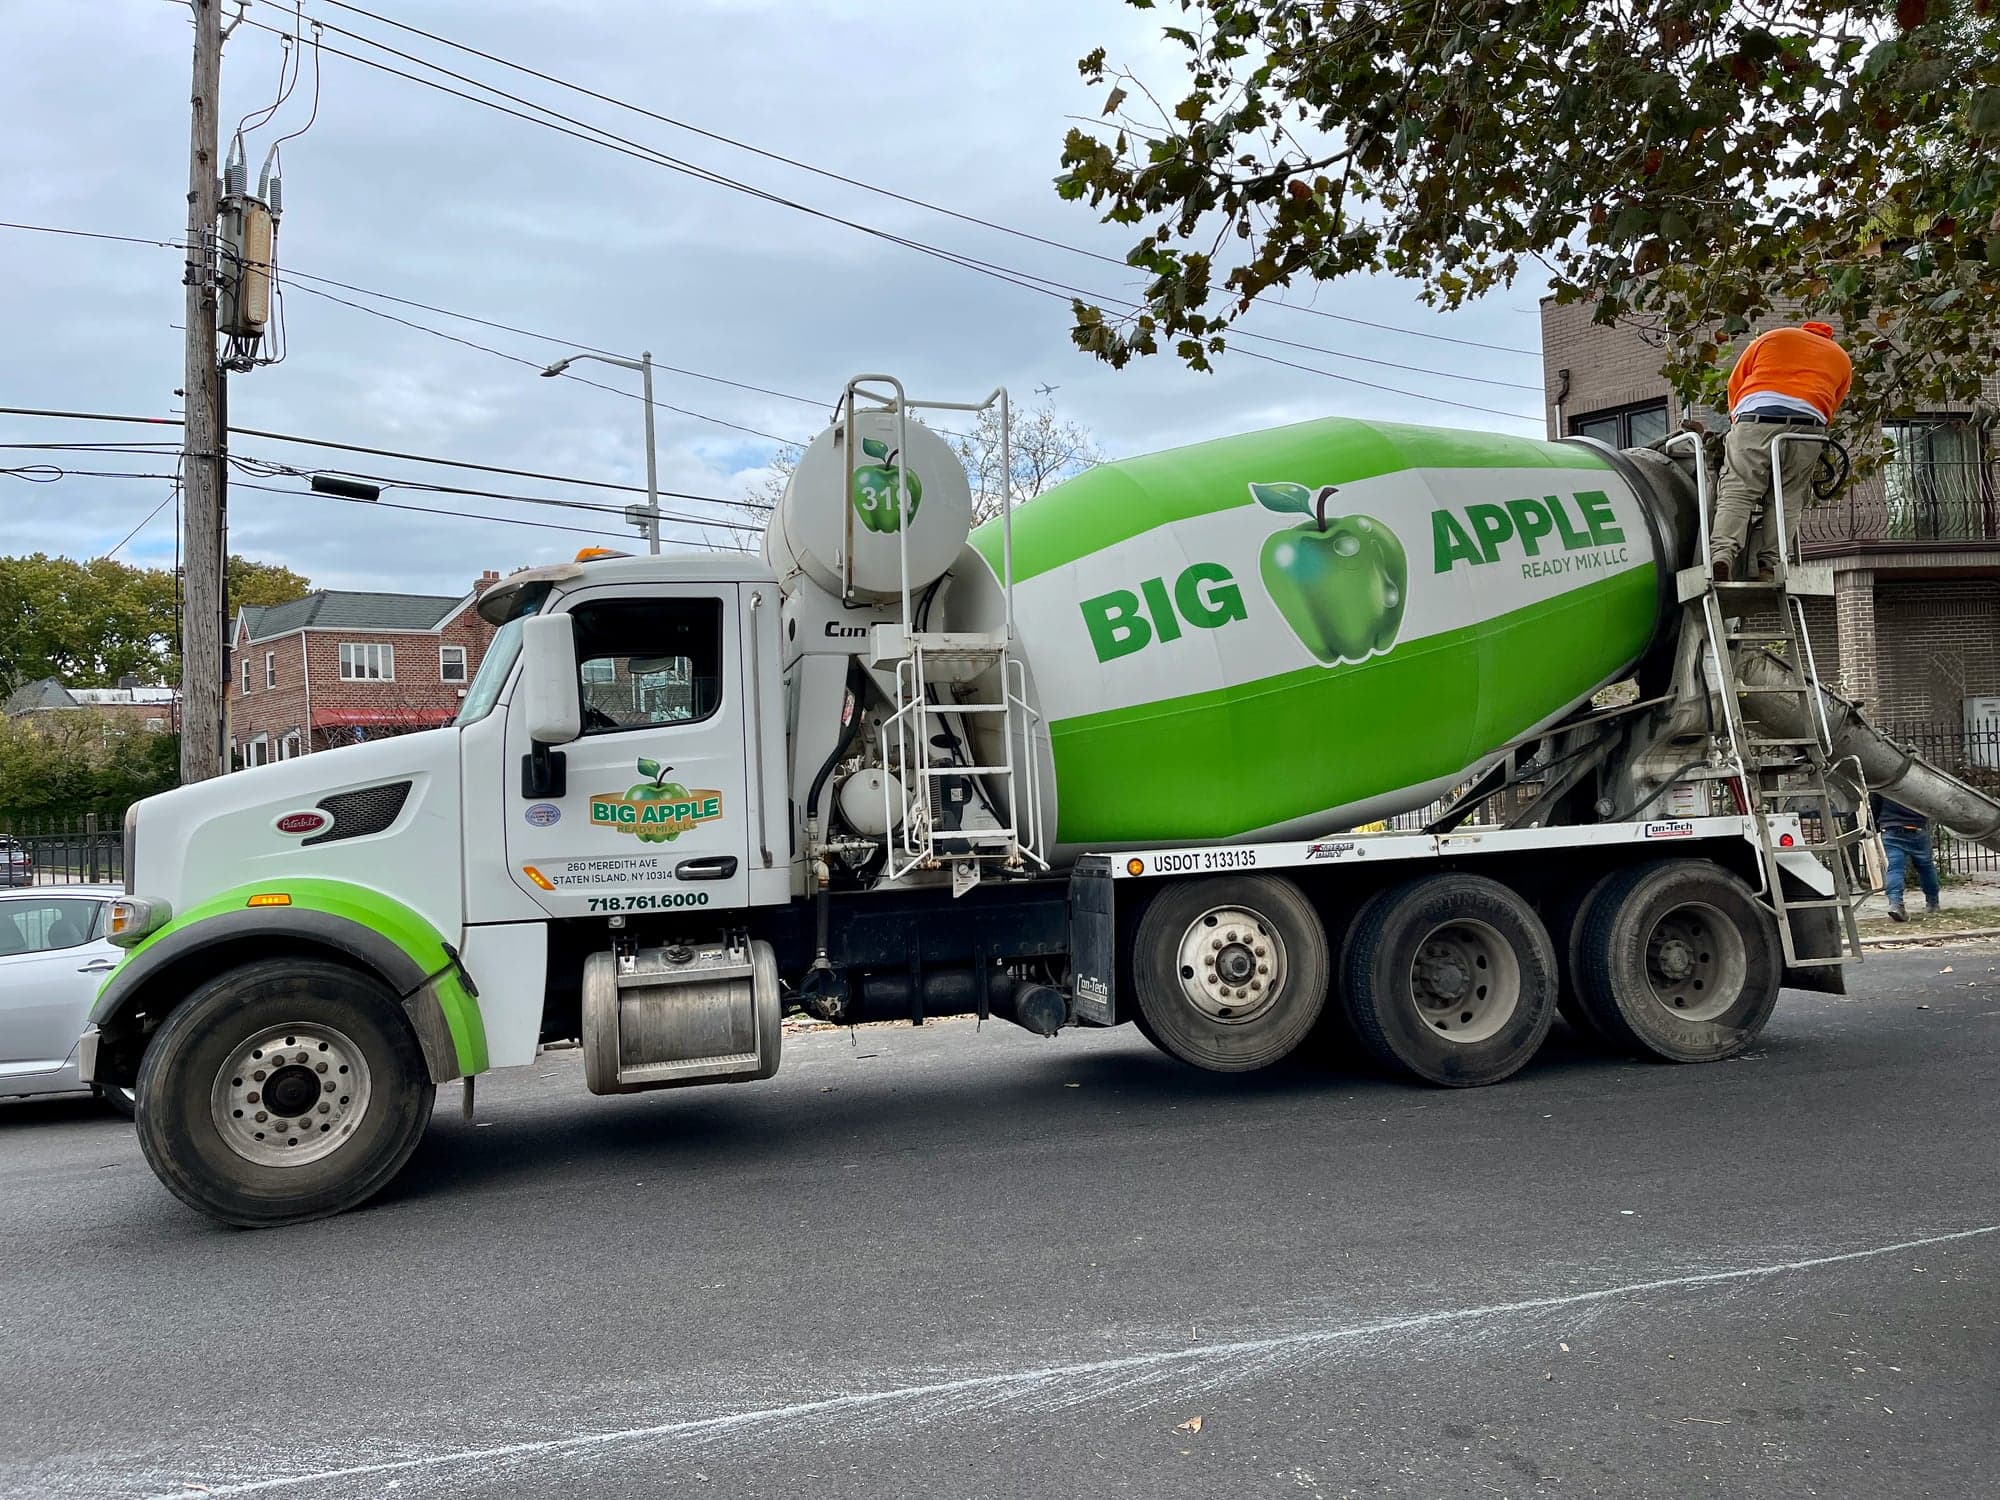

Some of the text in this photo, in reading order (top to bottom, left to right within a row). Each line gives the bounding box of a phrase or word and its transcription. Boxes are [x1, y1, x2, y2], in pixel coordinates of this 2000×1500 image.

[1521, 547, 1629, 580] READY MIX LLC
[1080, 490, 1627, 664] BIG APPLE
[593, 798, 720, 823] BIG APPLE
[282, 817, 320, 830] Peterbilt
[617, 822, 698, 834] READY MIX LLC
[1645, 822, 1693, 838] Con-Tech
[567, 858, 658, 872] 260 MEREDITH AVE
[1154, 850, 1256, 872] USDOT 3133135
[553, 871, 673, 885] STATEN ISLAND, NY 10314
[587, 892, 709, 912] 718.761.6000
[1077, 974, 1108, 995] Con-Tech
